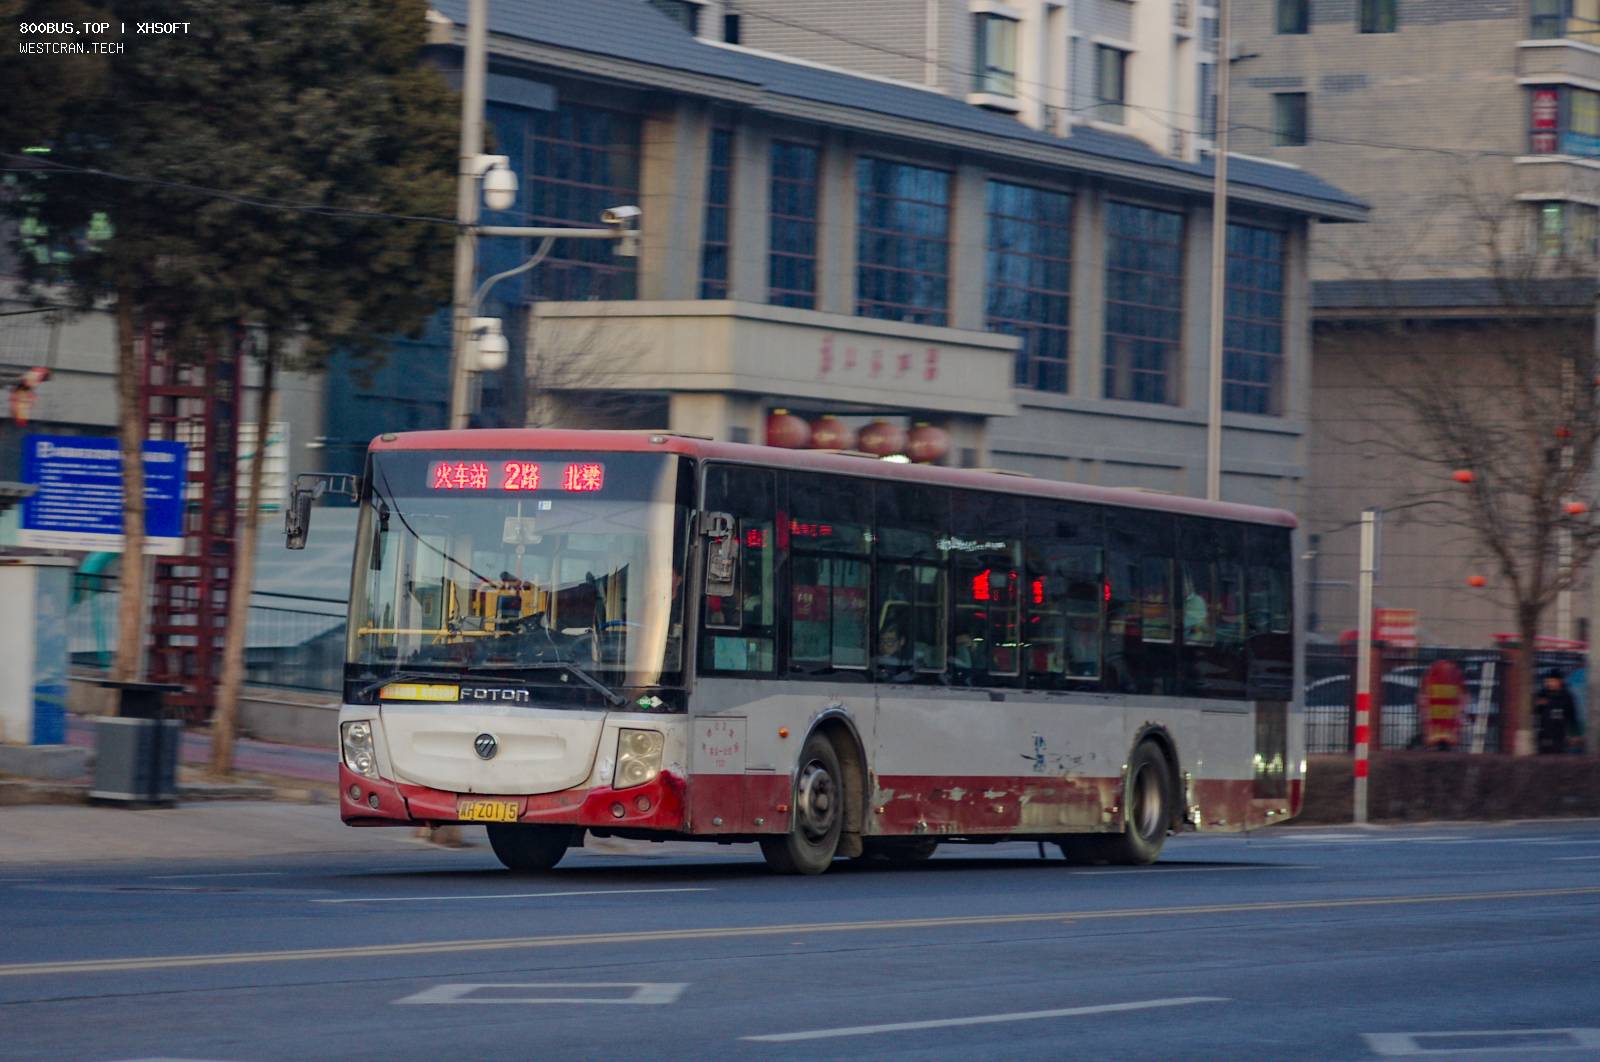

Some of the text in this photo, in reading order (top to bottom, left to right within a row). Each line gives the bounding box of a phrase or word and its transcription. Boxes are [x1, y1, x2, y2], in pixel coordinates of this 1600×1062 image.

[434, 463, 489, 489] 火车站
[504, 463, 540, 490] 2路
[460, 688, 529, 702] FOTON
